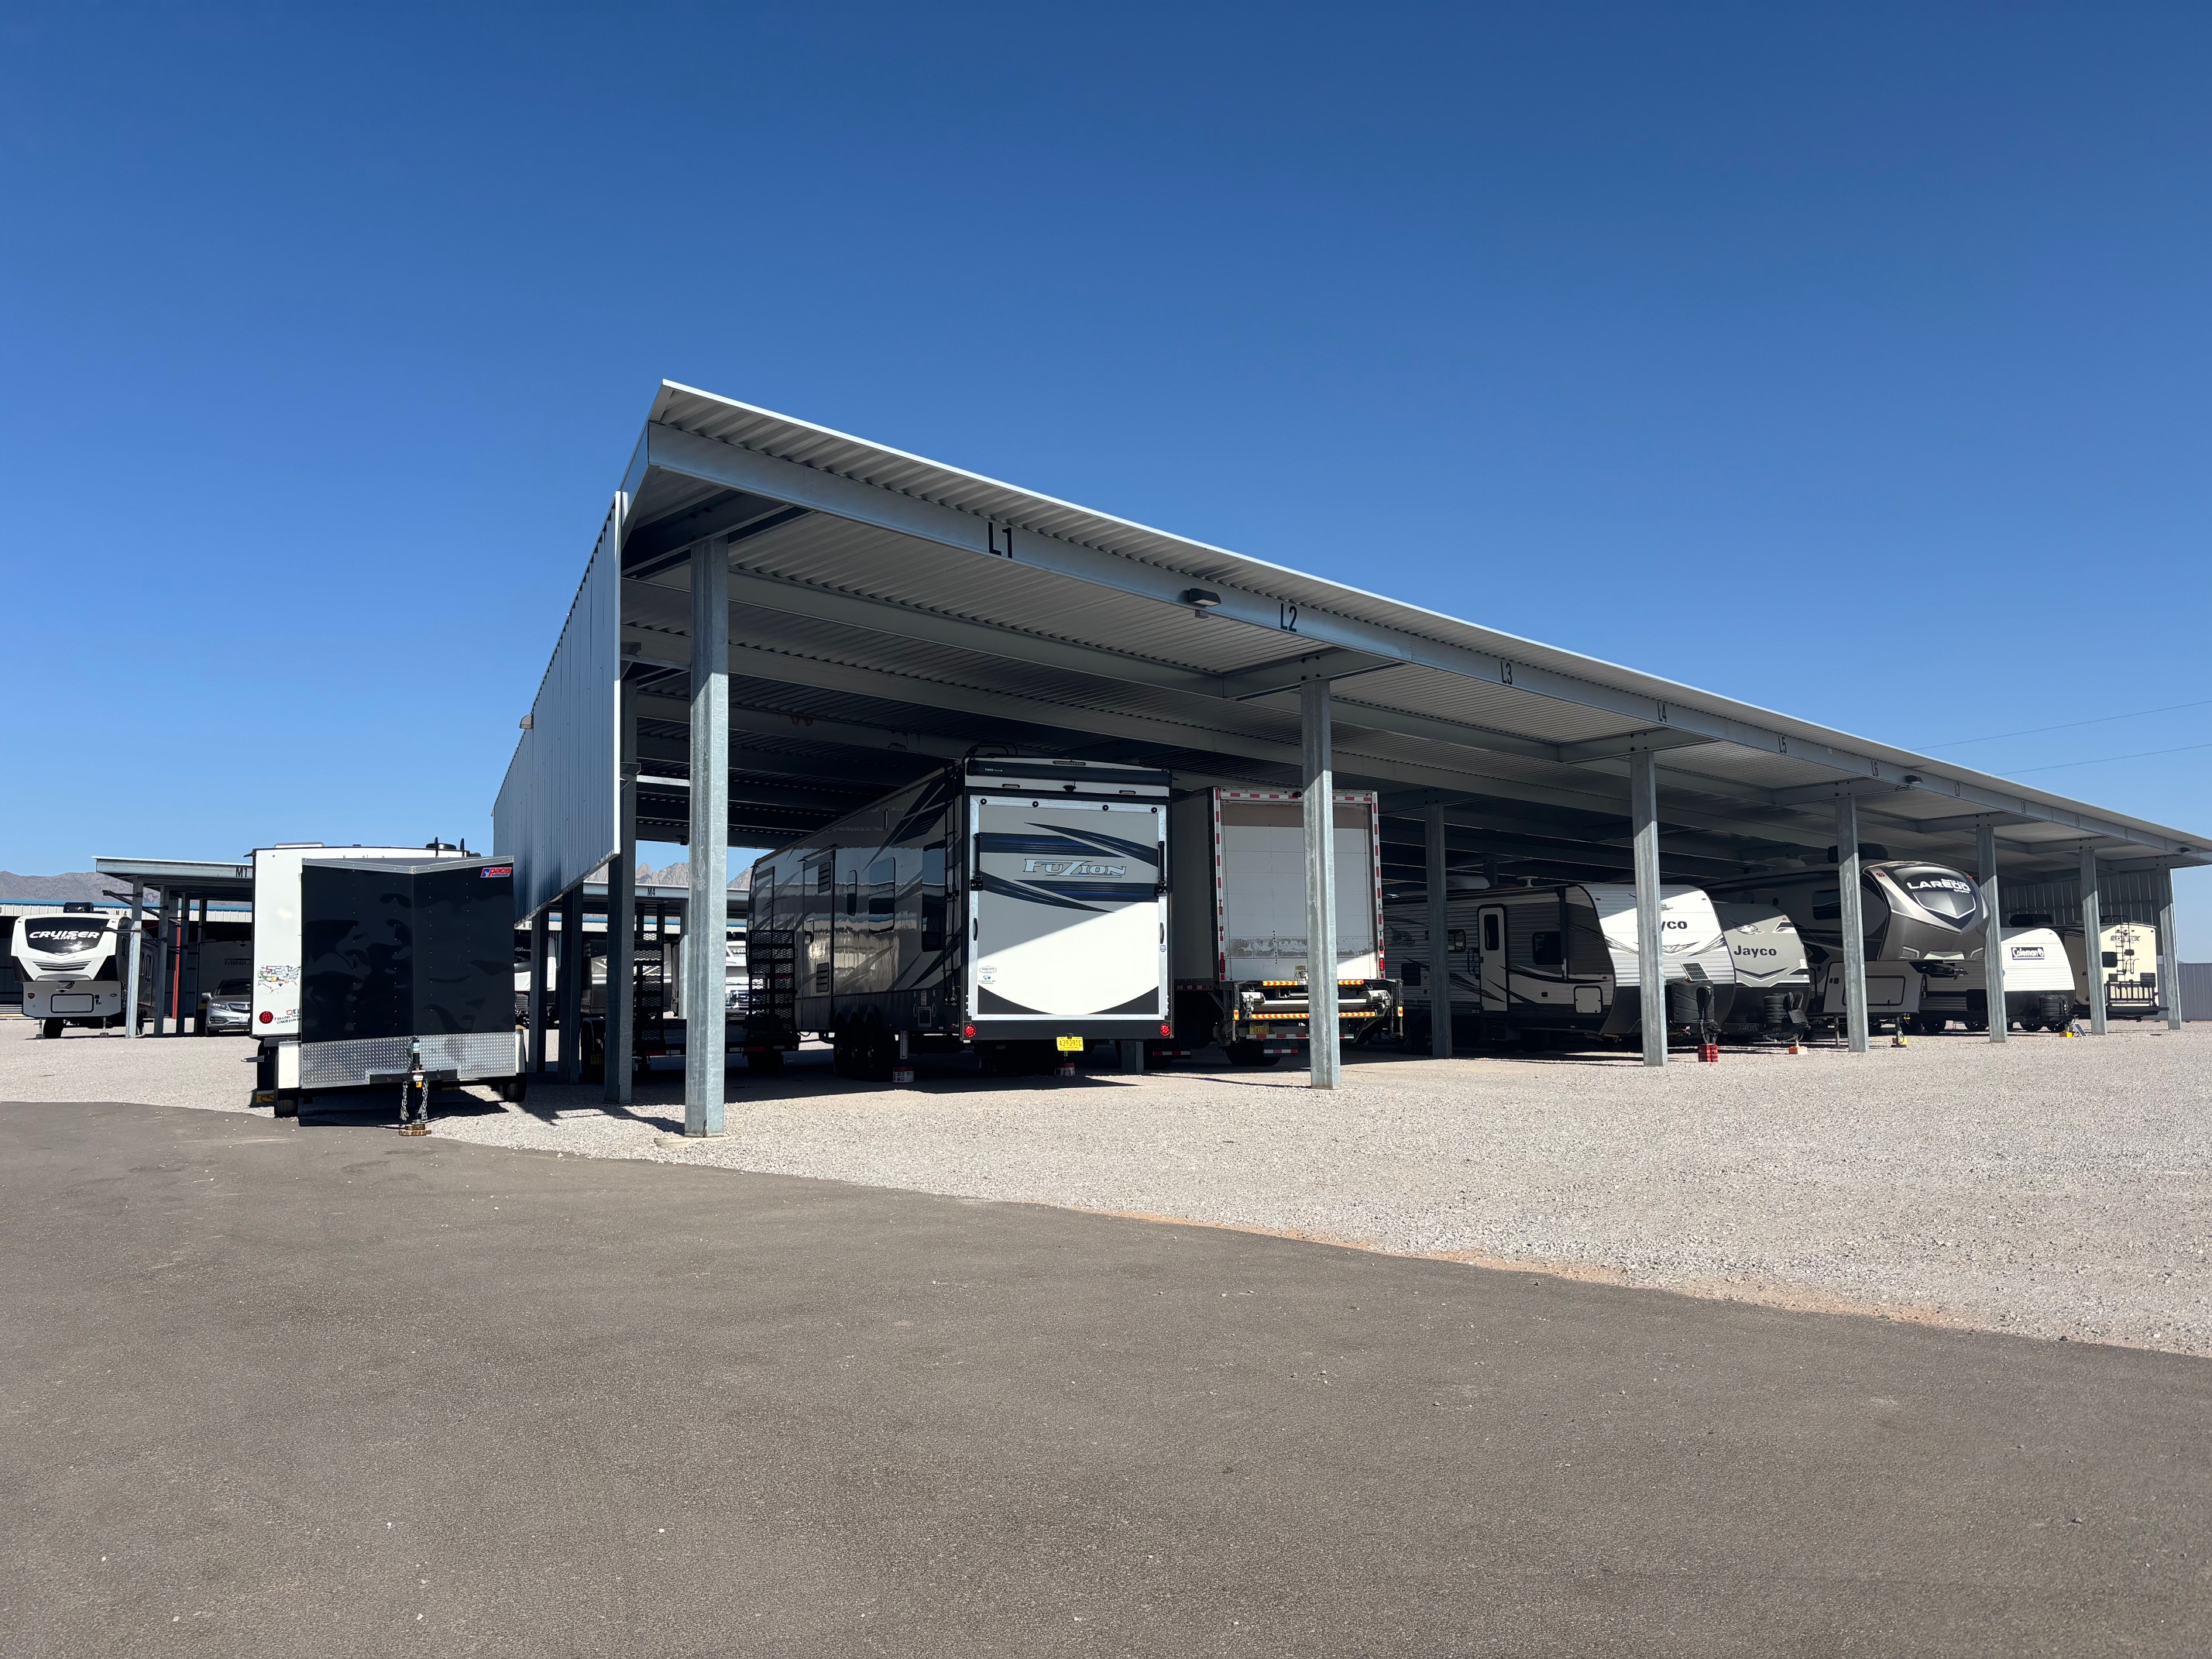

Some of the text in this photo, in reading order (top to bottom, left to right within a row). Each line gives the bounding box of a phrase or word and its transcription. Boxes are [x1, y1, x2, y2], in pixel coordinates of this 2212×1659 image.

[988, 521, 1013, 559] L1
[1280, 603, 1297, 633] L2
[1500, 661, 1513, 685] L3
[1657, 702, 1668, 723] L4
[1778, 735, 1788, 754] L5
[1870, 760, 1879, 777] L6
[1954, 781, 1960, 797] L7
[235, 867, 248, 878] M1
[1022, 859, 1127, 878] FUZION
[647, 887, 656, 897] M4
[1906, 881, 1971, 891] LAREDO
[29, 930, 101, 939] CRUISER
[1733, 945, 1778, 958] Jayco
[2012, 947, 2039, 957] Coleman
